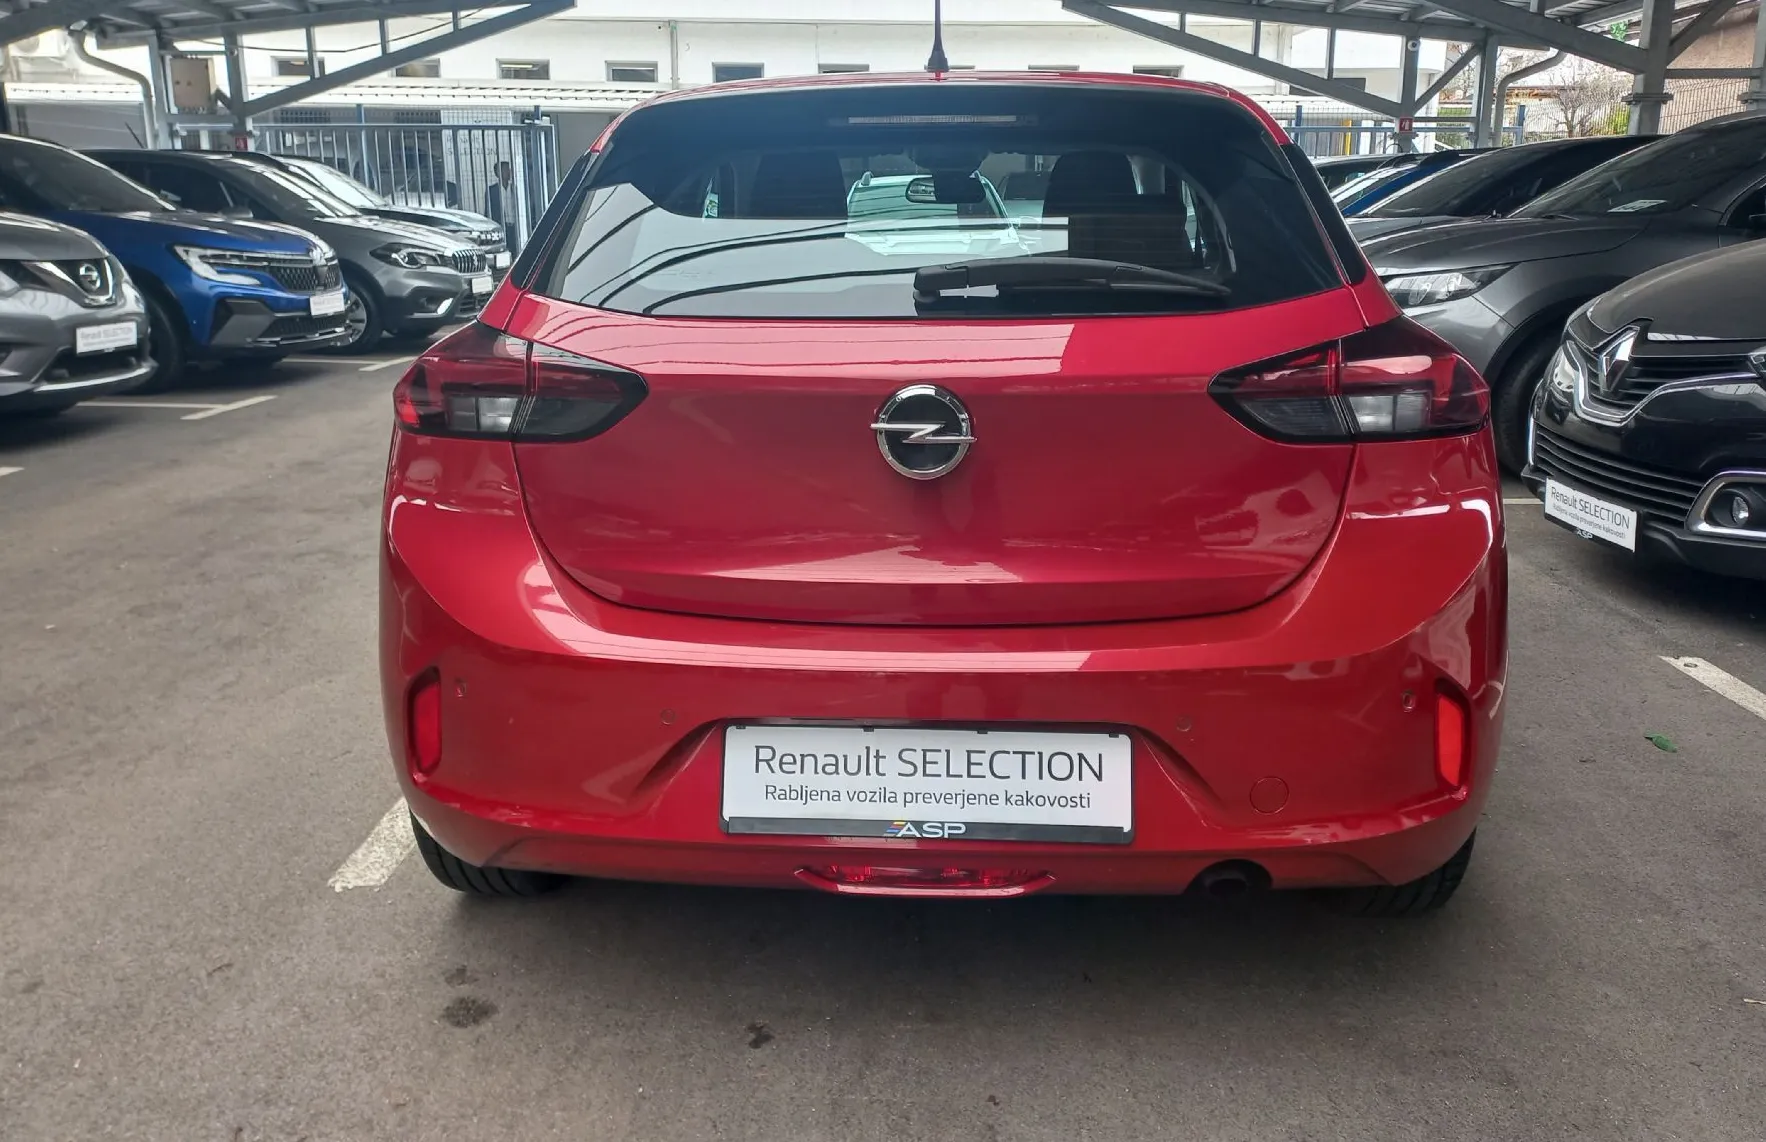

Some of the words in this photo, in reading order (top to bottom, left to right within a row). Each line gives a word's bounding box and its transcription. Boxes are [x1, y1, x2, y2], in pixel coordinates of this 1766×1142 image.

[1551, 487, 1578, 509] Renault
[1579, 499, 1630, 529] SELECTION
[755, 745, 887, 777] Renault
[897, 748, 1103, 782] SELECTION
[765, 785, 841, 805] Rabljena
[846, 787, 898, 804] vozila
[903, 789, 1000, 809] preverjene
[1004, 790, 1091, 809] kakovosti
[896, 821, 966, 839] ASP
